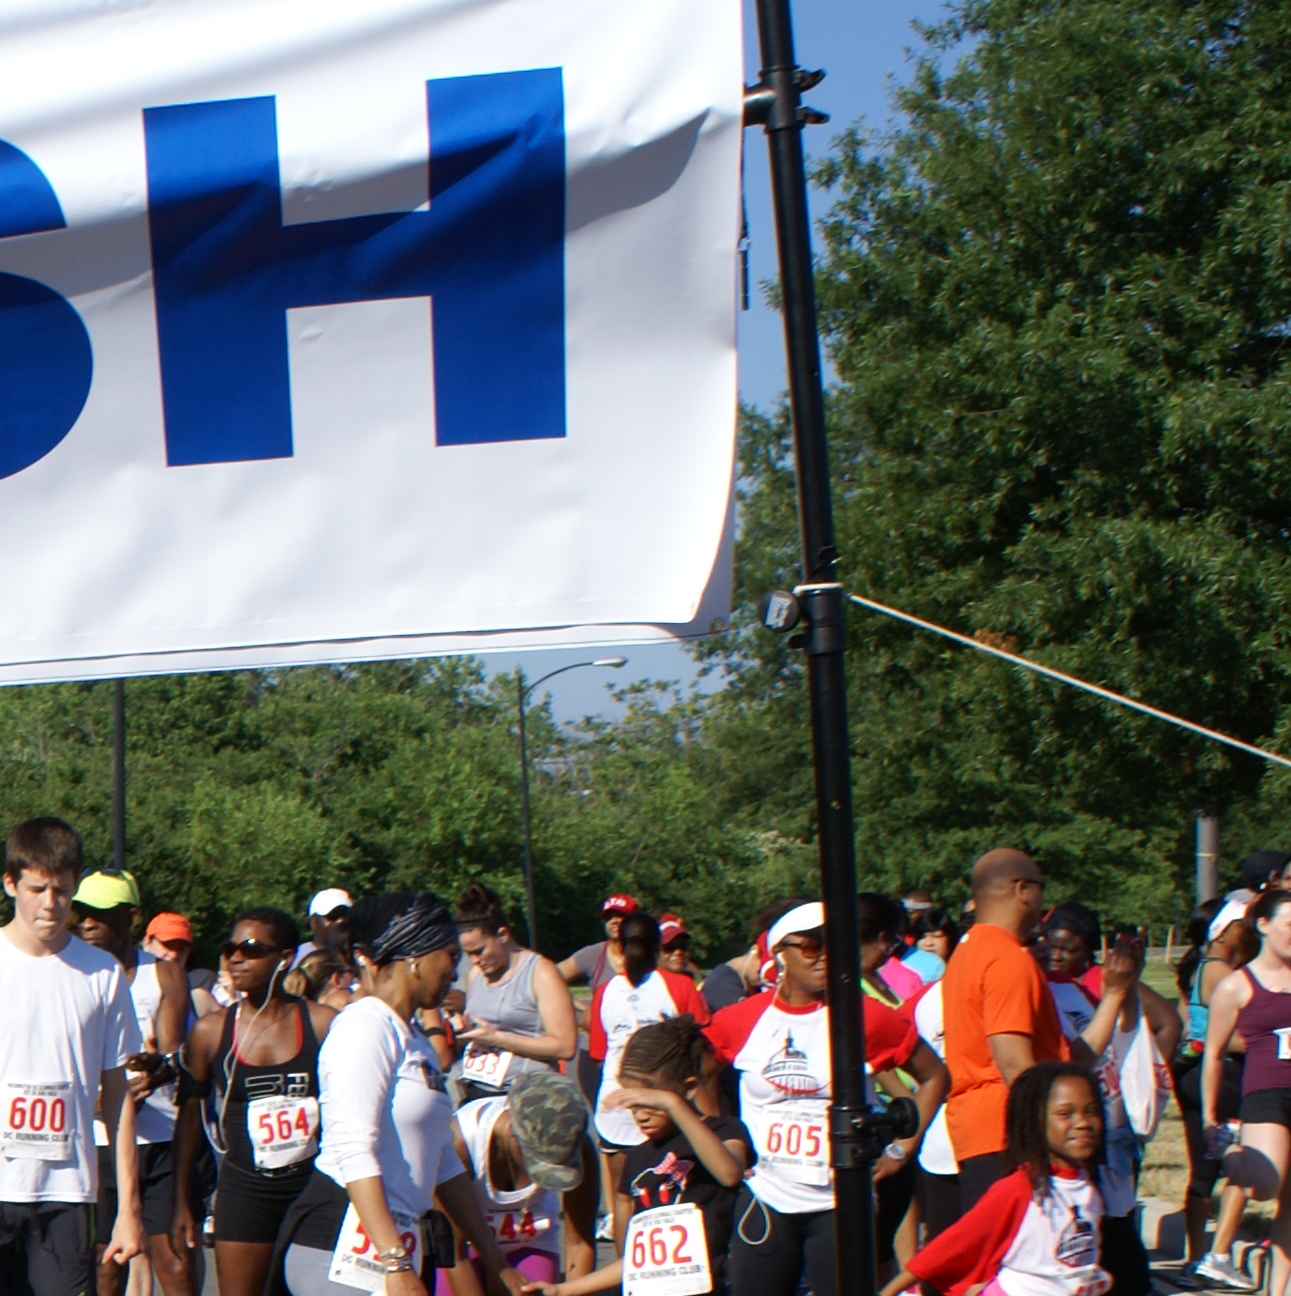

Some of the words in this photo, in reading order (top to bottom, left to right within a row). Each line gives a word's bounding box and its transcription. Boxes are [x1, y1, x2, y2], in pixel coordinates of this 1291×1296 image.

[8, 1096, 66, 1133] 600
[258, 1106, 311, 1145] 564
[766, 1121, 823, 1158] 605
[350, 1220, 418, 1262] 59
[631, 1224, 693, 1269] 662
